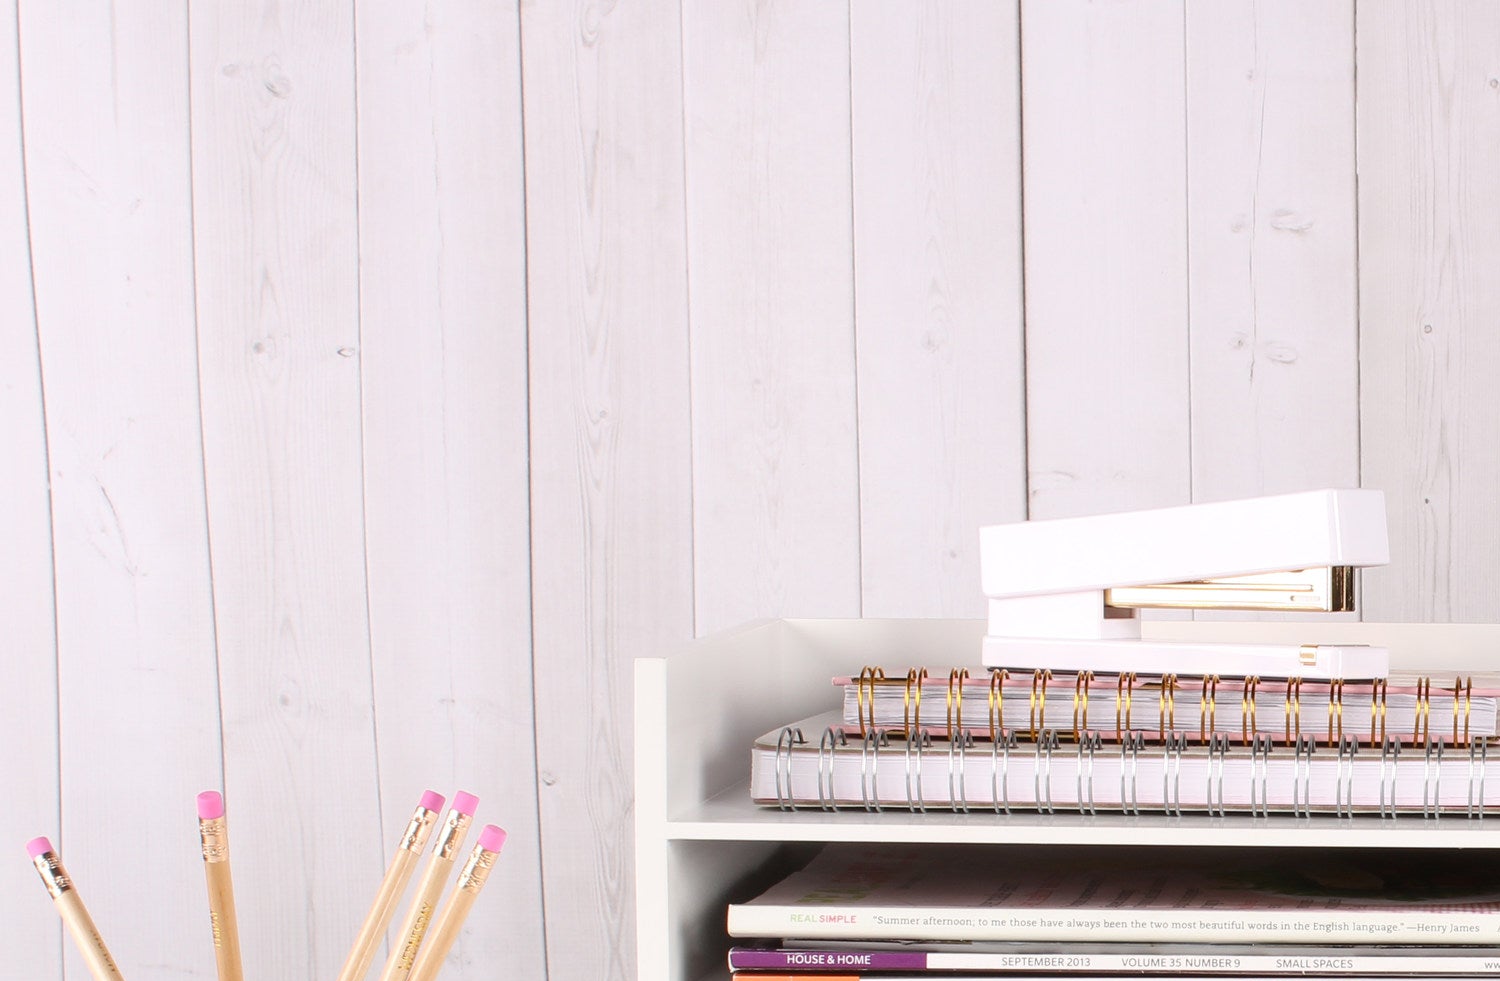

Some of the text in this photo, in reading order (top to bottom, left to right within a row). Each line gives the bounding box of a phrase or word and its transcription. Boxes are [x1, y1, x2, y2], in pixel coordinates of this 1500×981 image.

[790, 914, 817, 923] REAL
[819, 915, 856, 924] SIMPLE
[1010, 918, 1037, 927] those
[1041, 919, 1063, 927] have
[1067, 919, 1100, 930] always
[1104, 920, 1127, 928] been
[1131, 920, 1147, 928] the
[1150, 921, 1168, 929] two
[1200, 921, 1244, 930] beautiful
[1248, 921, 1278, 931] words
[1281, 922, 1291, 930] in
[1294, 922, 1310, 931] the
[1313, 922, 1349, 933] English
[1450, 924, 1479, 933] James
[787, 955, 871, 965] HOUSE & HOME
[1002, 958, 1091, 967] SEPTEMBER 2013
[1121, 958, 1241, 968] VOLUME 35 NUMBER 9
[1276, 959, 1353, 968] SMALL SPACES
